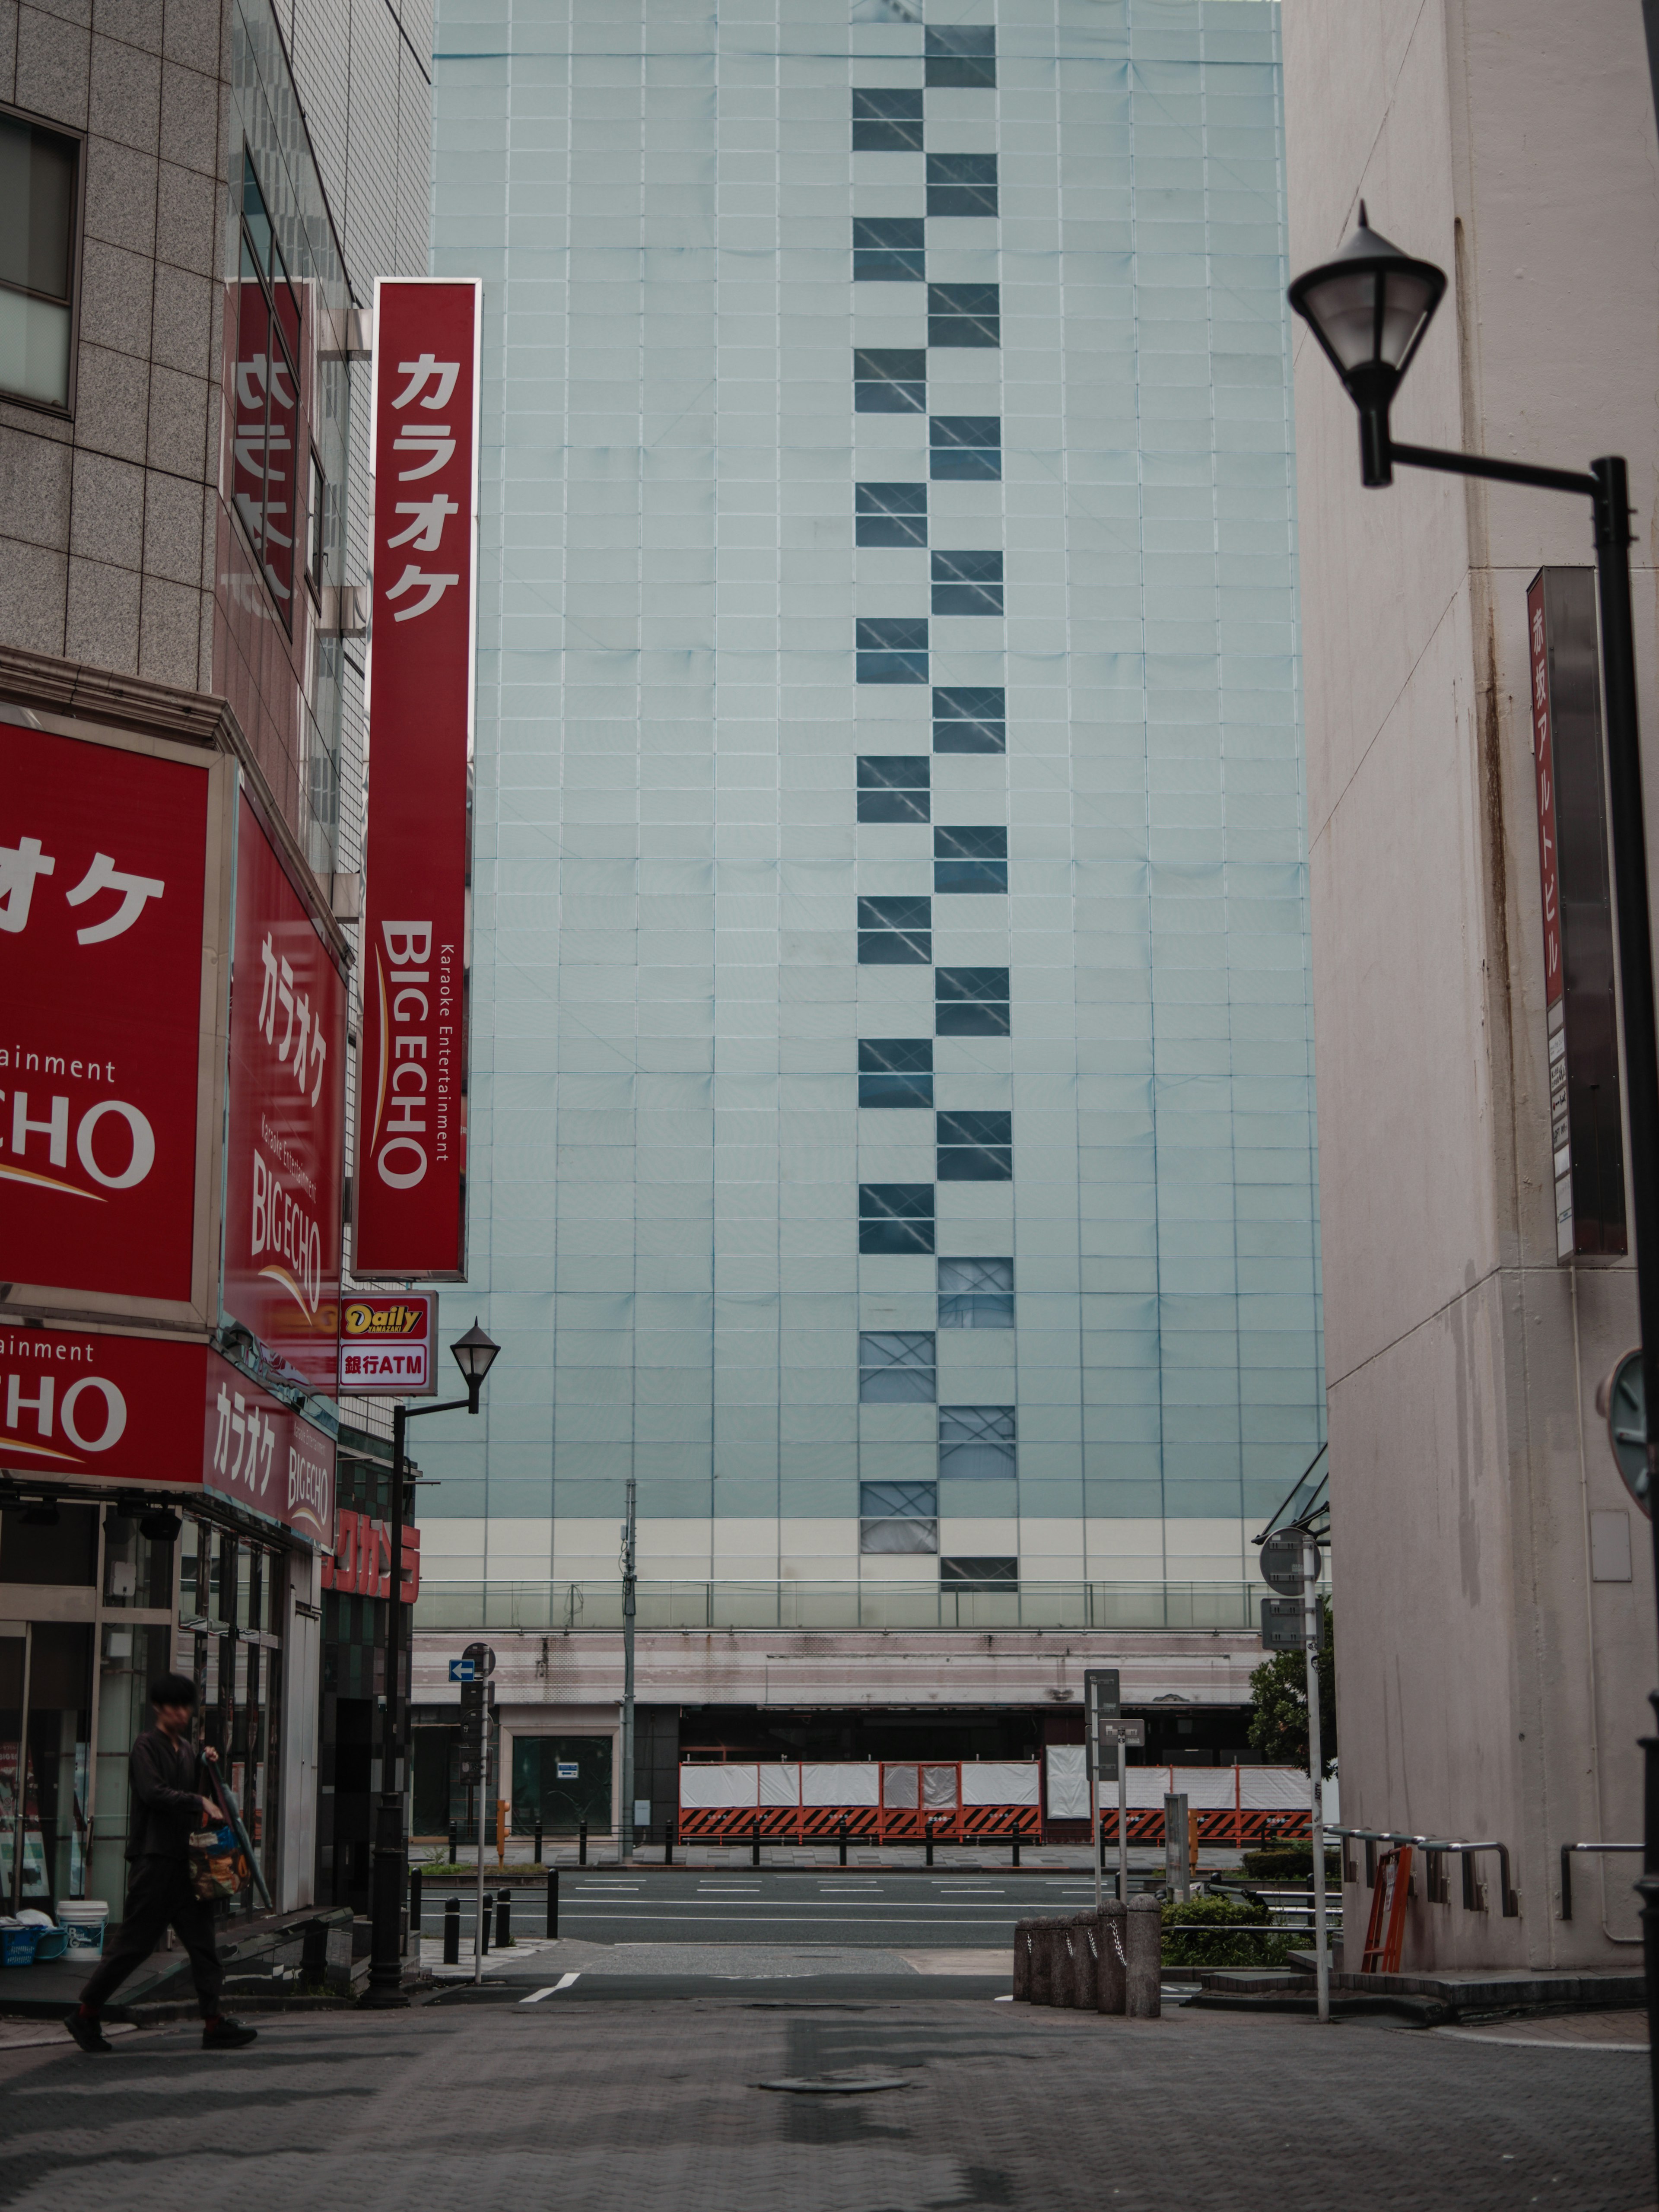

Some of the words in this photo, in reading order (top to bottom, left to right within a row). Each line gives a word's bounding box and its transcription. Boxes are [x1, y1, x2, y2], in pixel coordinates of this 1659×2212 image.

[385, 353, 460, 622] カラオケ
[1533, 607, 1557, 978] 赤坂アルトビル
[259, 931, 326, 1108] カラオケ
[382, 921, 432, 1021] BIG
[440, 944, 454, 1017] Karaoke
[0, 1089, 155, 1189] HO
[378, 1036, 427, 1189] ECHO
[436, 1027, 453, 1161] Entertainment
[262, 1112, 282, 1161] Karaoke
[284, 1141, 316, 1204] Entertainment
[345, 1304, 423, 1334] Daily
[345, 1356, 422, 1374] 銀行ATM
[0, 1374, 127, 1452] HO
[214, 1382, 275, 1497] カラオケ
